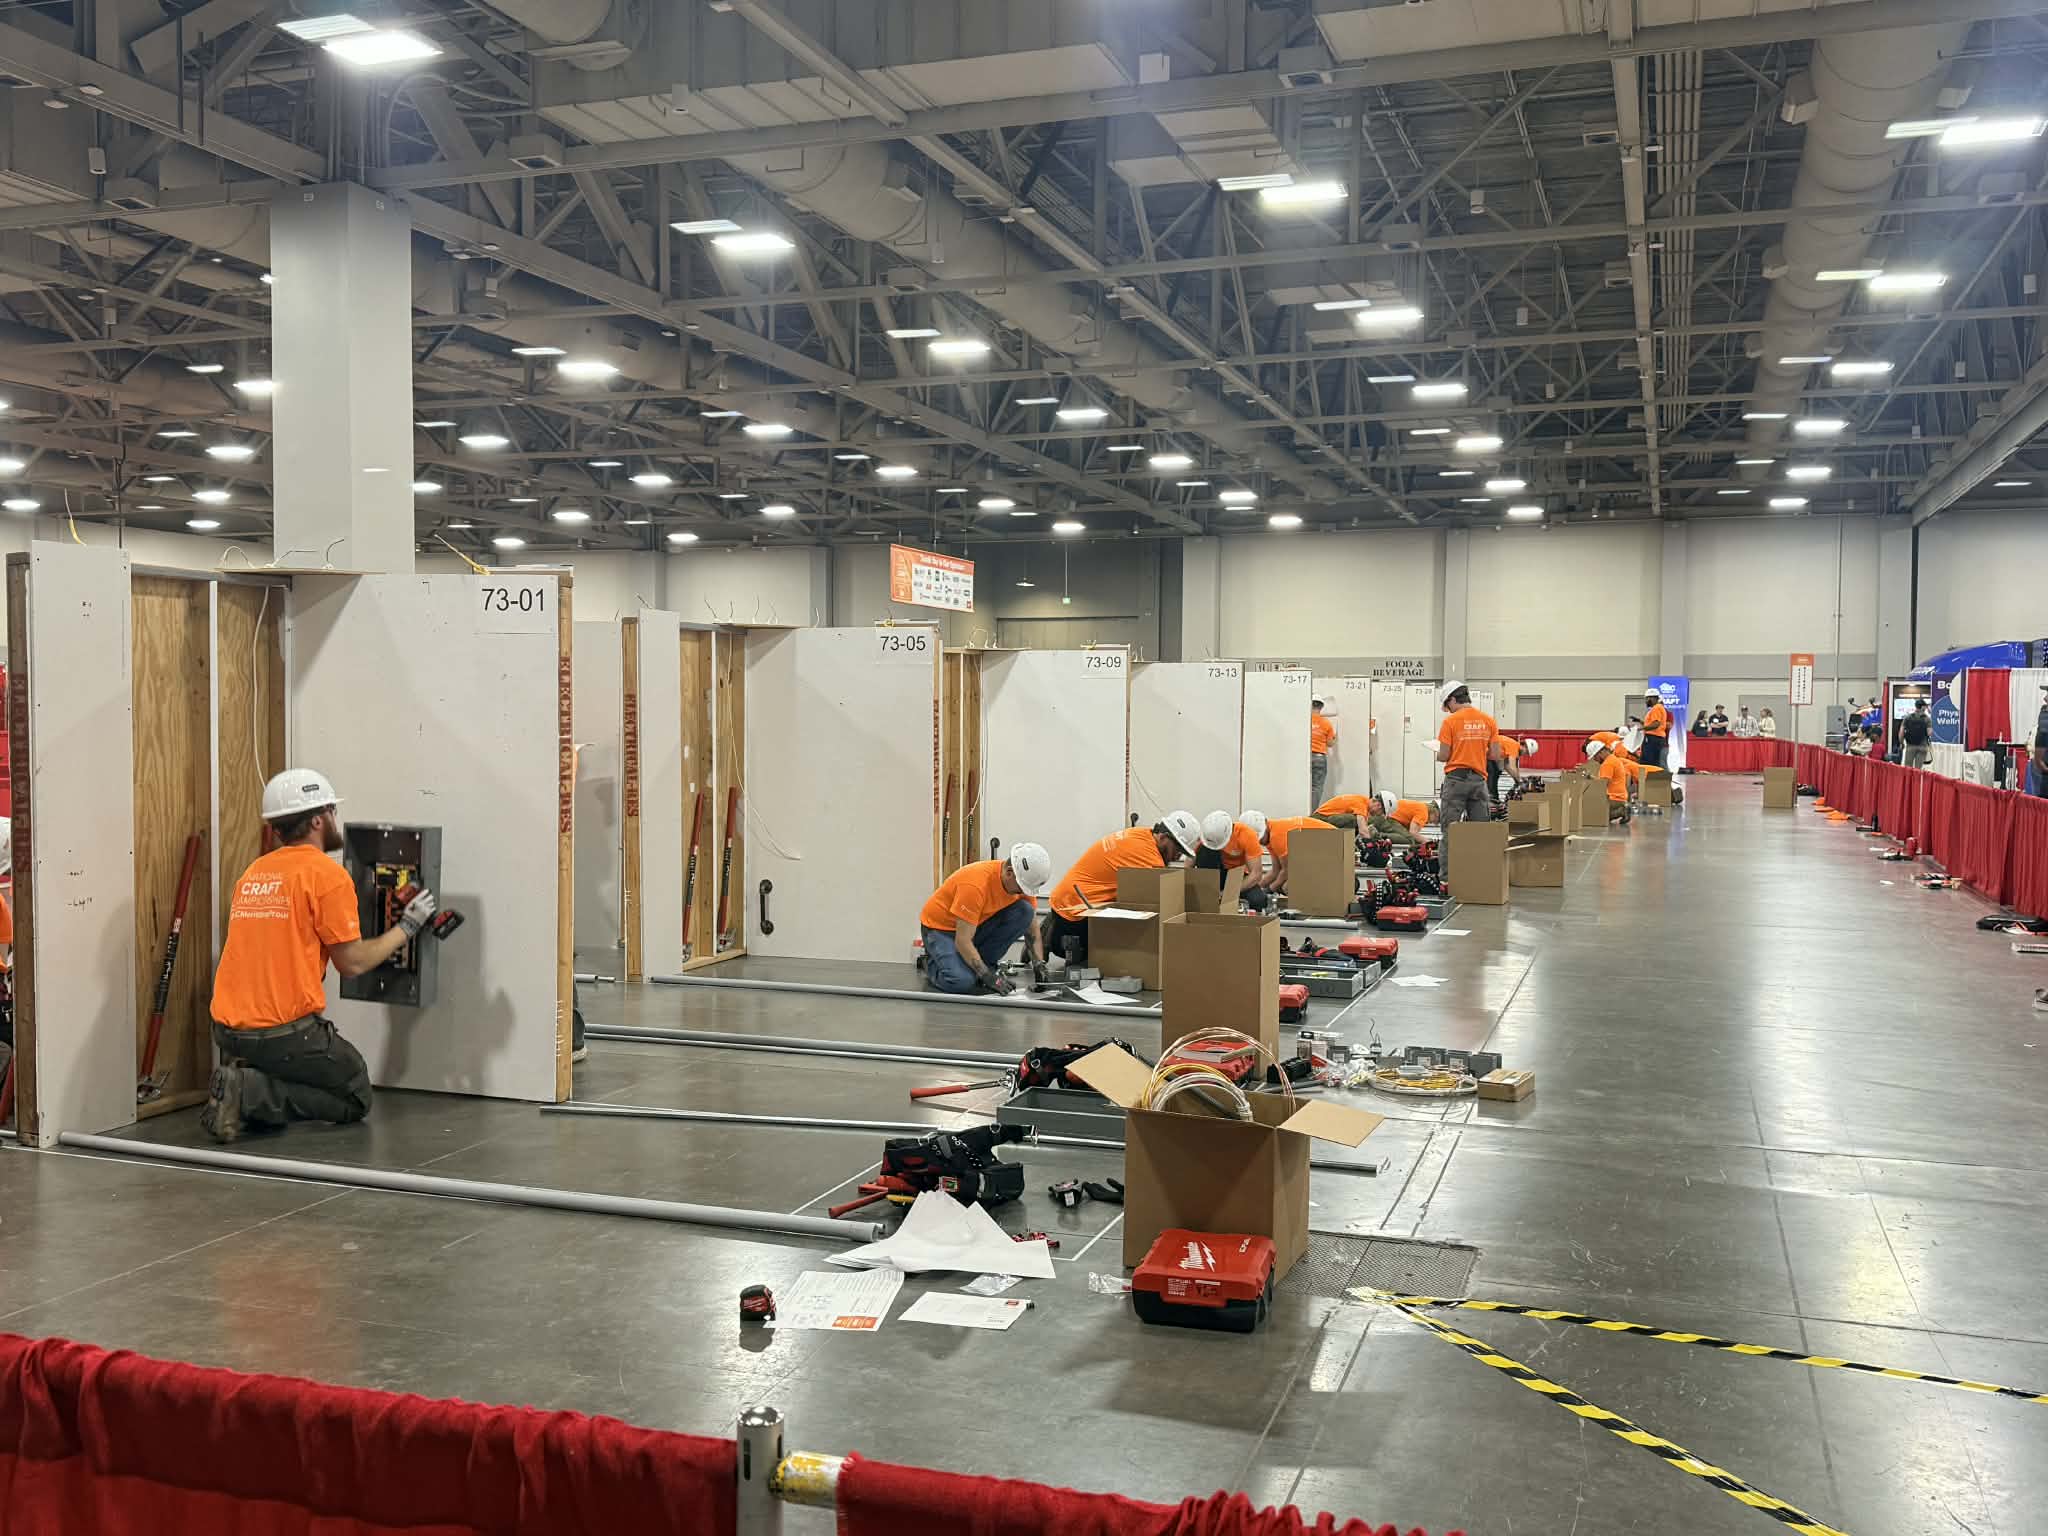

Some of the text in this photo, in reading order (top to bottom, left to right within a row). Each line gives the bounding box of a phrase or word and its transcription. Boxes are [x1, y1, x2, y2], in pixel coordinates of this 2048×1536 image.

[481, 588, 544, 612] 73-01
[880, 635, 926, 651] 73-05
[1086, 656, 1122, 668] 73-09
[1385, 660, 1424, 668] FOOD &
[1208, 668, 1237, 678] 73-13
[1373, 668, 1425, 677] BEVERAGE
[1283, 675, 1308, 684] 73-17
[1345, 681, 1366, 690] 73-21
[241, 881, 283, 896] CRAFT
